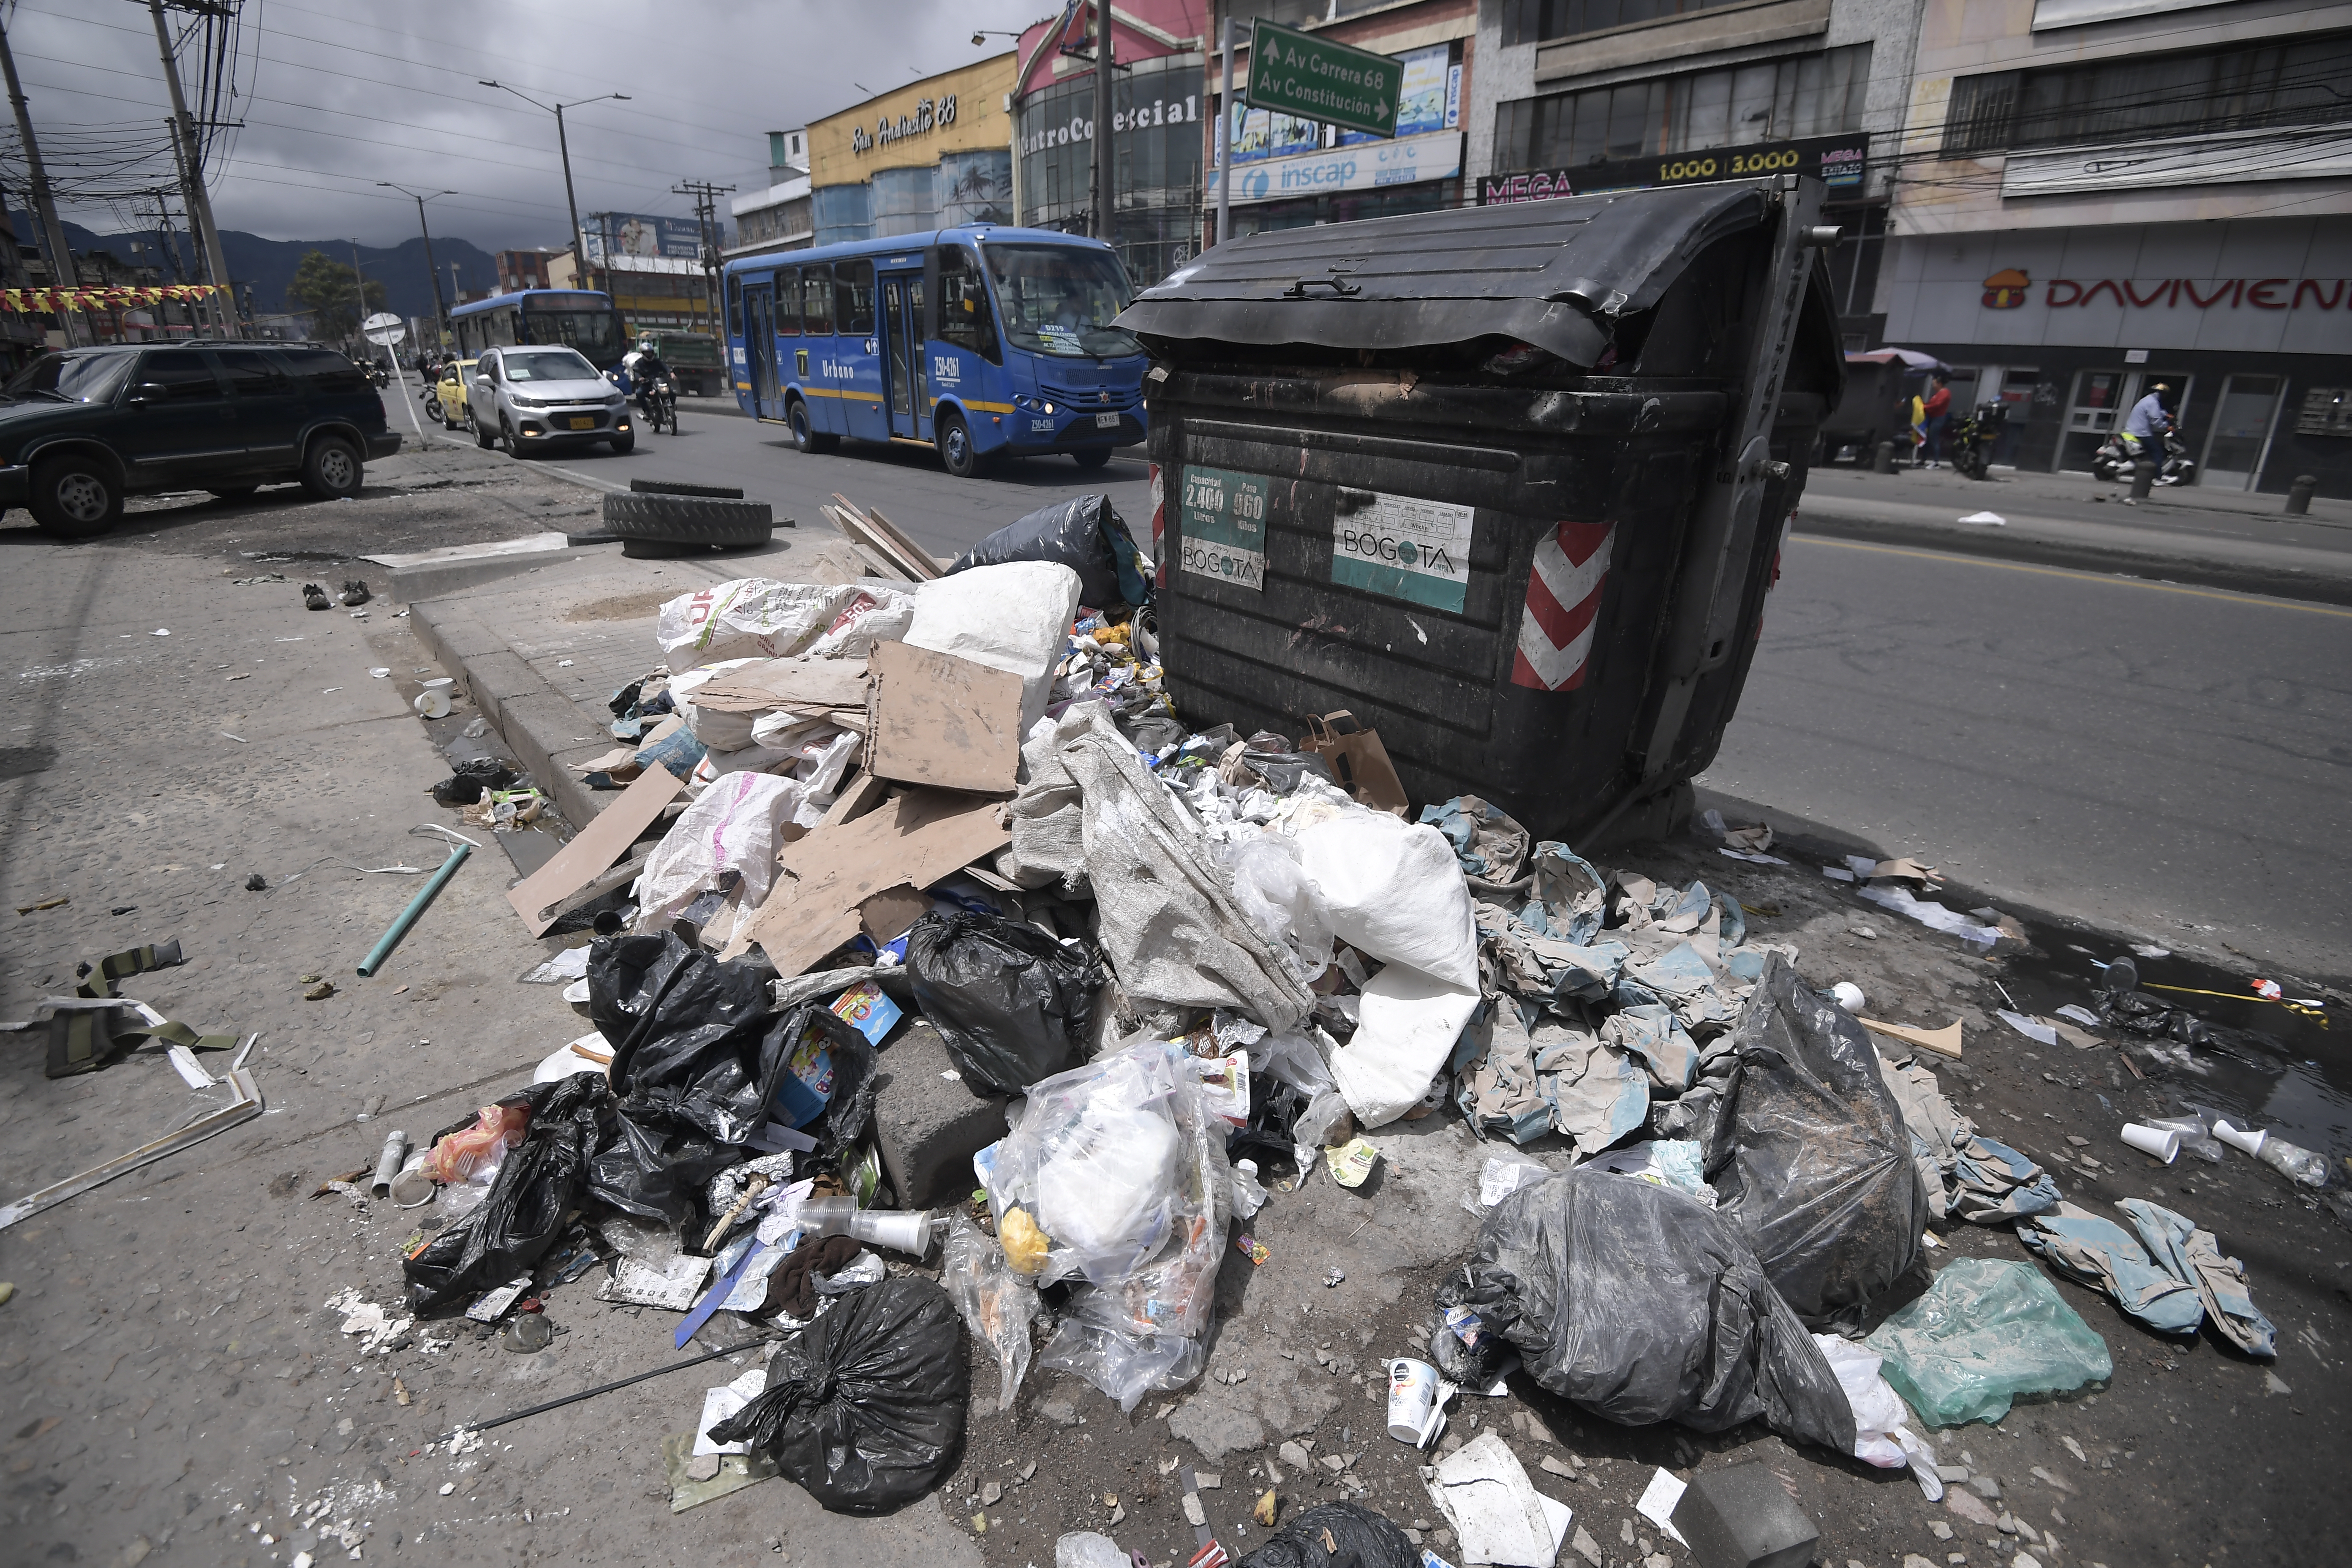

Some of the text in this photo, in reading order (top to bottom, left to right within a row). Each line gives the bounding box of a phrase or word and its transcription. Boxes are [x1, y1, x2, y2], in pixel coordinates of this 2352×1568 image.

[1285, 47, 1306, 68] Av
[1311, 54, 1360, 84] Carrera
[1364, 70, 1383, 90] 68
[1260, 72, 1370, 115] Av Constitución
[853, 127, 873, 153] San
[936, 94, 956, 125] 68
[1821, 148, 1863, 164] MEGA
[1282, 161, 1357, 188] inscap
[1661, 158, 1717, 181] 1.000
[1486, 171, 1573, 205] MEGA
[2047, 278, 2352, 309] DAVIVIEN
[822, 359, 854, 378] Urbano
[935, 356, 959, 377] Z50-4261
[1032, 419, 1054, 429] Z50-4261
[1190, 474, 1221, 487] Capacidad
[1186, 484, 1224, 512] 2.400
[1233, 492, 1263, 520] 960
[1194, 511, 1215, 524] Litros
[1237, 520, 1257, 533] Kilos
[1412, 523, 1428, 531] Noche
[1344, 530, 1455, 574] BOGOTÁ
[1434, 563, 1449, 573] LIMPIA
[846, 603, 865, 620] 50
[471, 1293, 489, 1309] Koyo
[1448, 1308, 1472, 1323] Rothman
